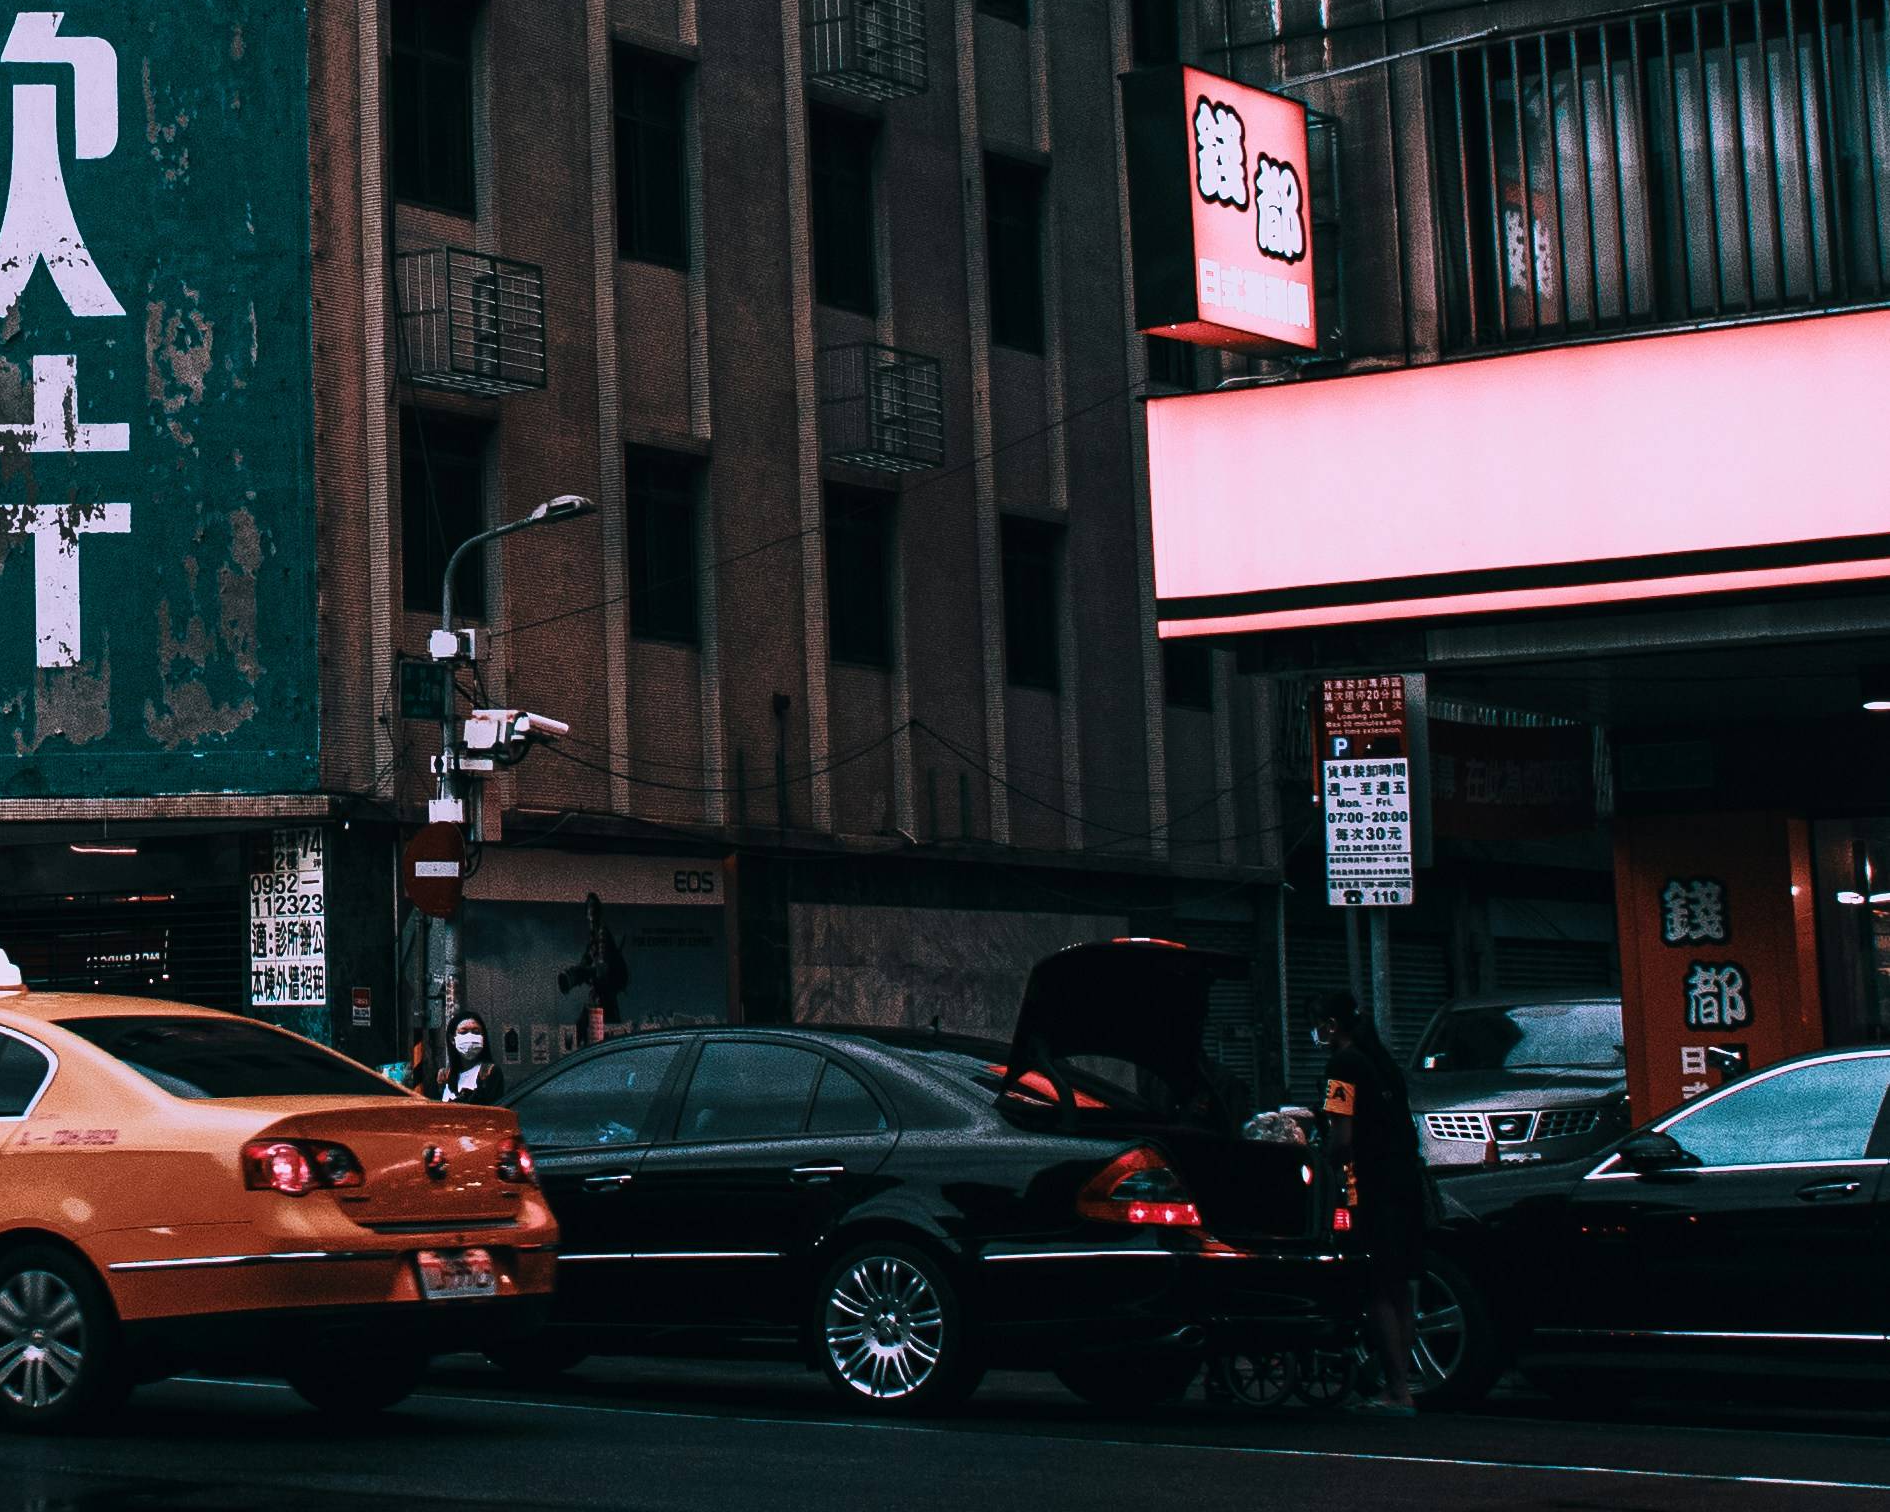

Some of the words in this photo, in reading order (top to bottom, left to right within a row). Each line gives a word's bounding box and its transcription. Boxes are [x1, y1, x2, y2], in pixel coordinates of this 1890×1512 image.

[1333, 737, 1348, 757] P
[1327, 763, 1406, 778] 貨車裝卸時間
[1327, 781, 1407, 796] 週一至週五
[1336, 798, 1362, 808] Mon.
[298, 828, 322, 859] 74
[673, 871, 715, 893] EOS
[252, 894, 323, 918] 112323
[1372, 890, 1399, 903] 110
[1662, 879, 1747, 1026] 錢都
